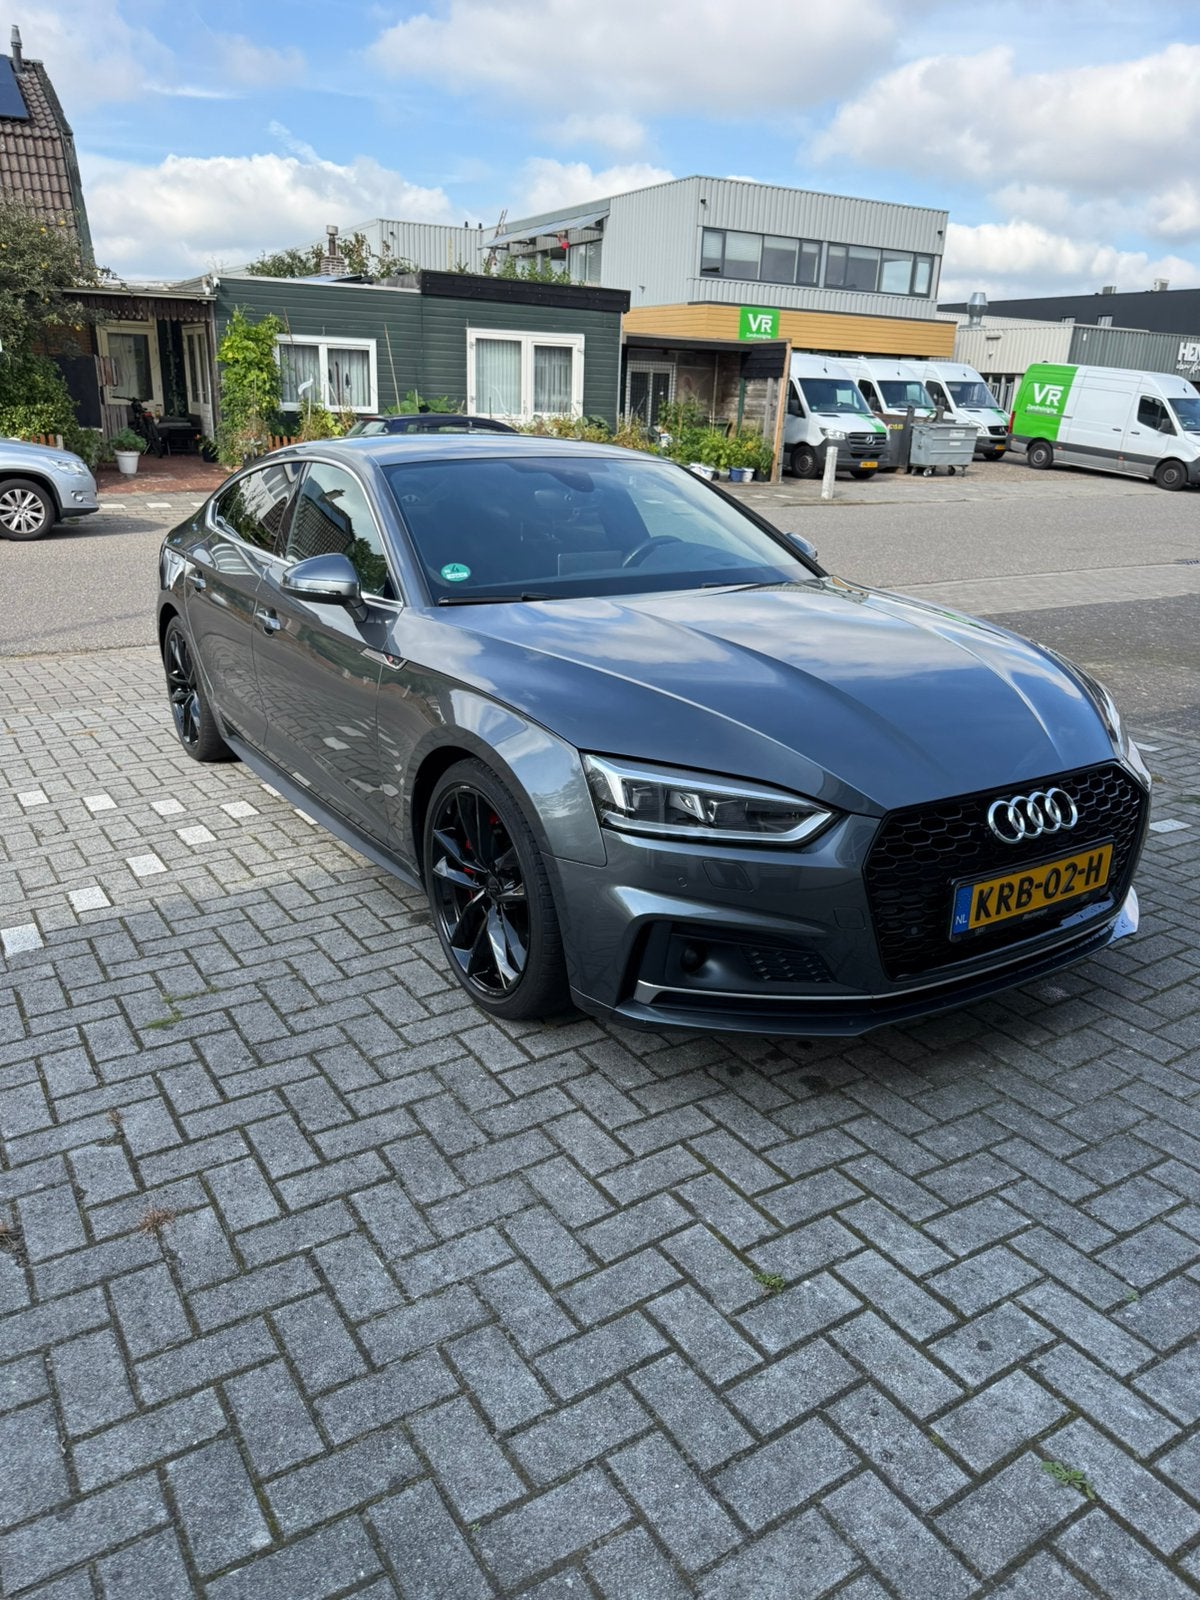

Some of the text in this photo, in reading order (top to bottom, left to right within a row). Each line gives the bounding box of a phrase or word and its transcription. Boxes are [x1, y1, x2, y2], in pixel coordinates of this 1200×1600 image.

[747, 313, 773, 333] VR
[1033, 383, 1064, 406] VR
[974, 853, 1103, 921] KRB-02-H
[954, 914, 968, 926] NL
